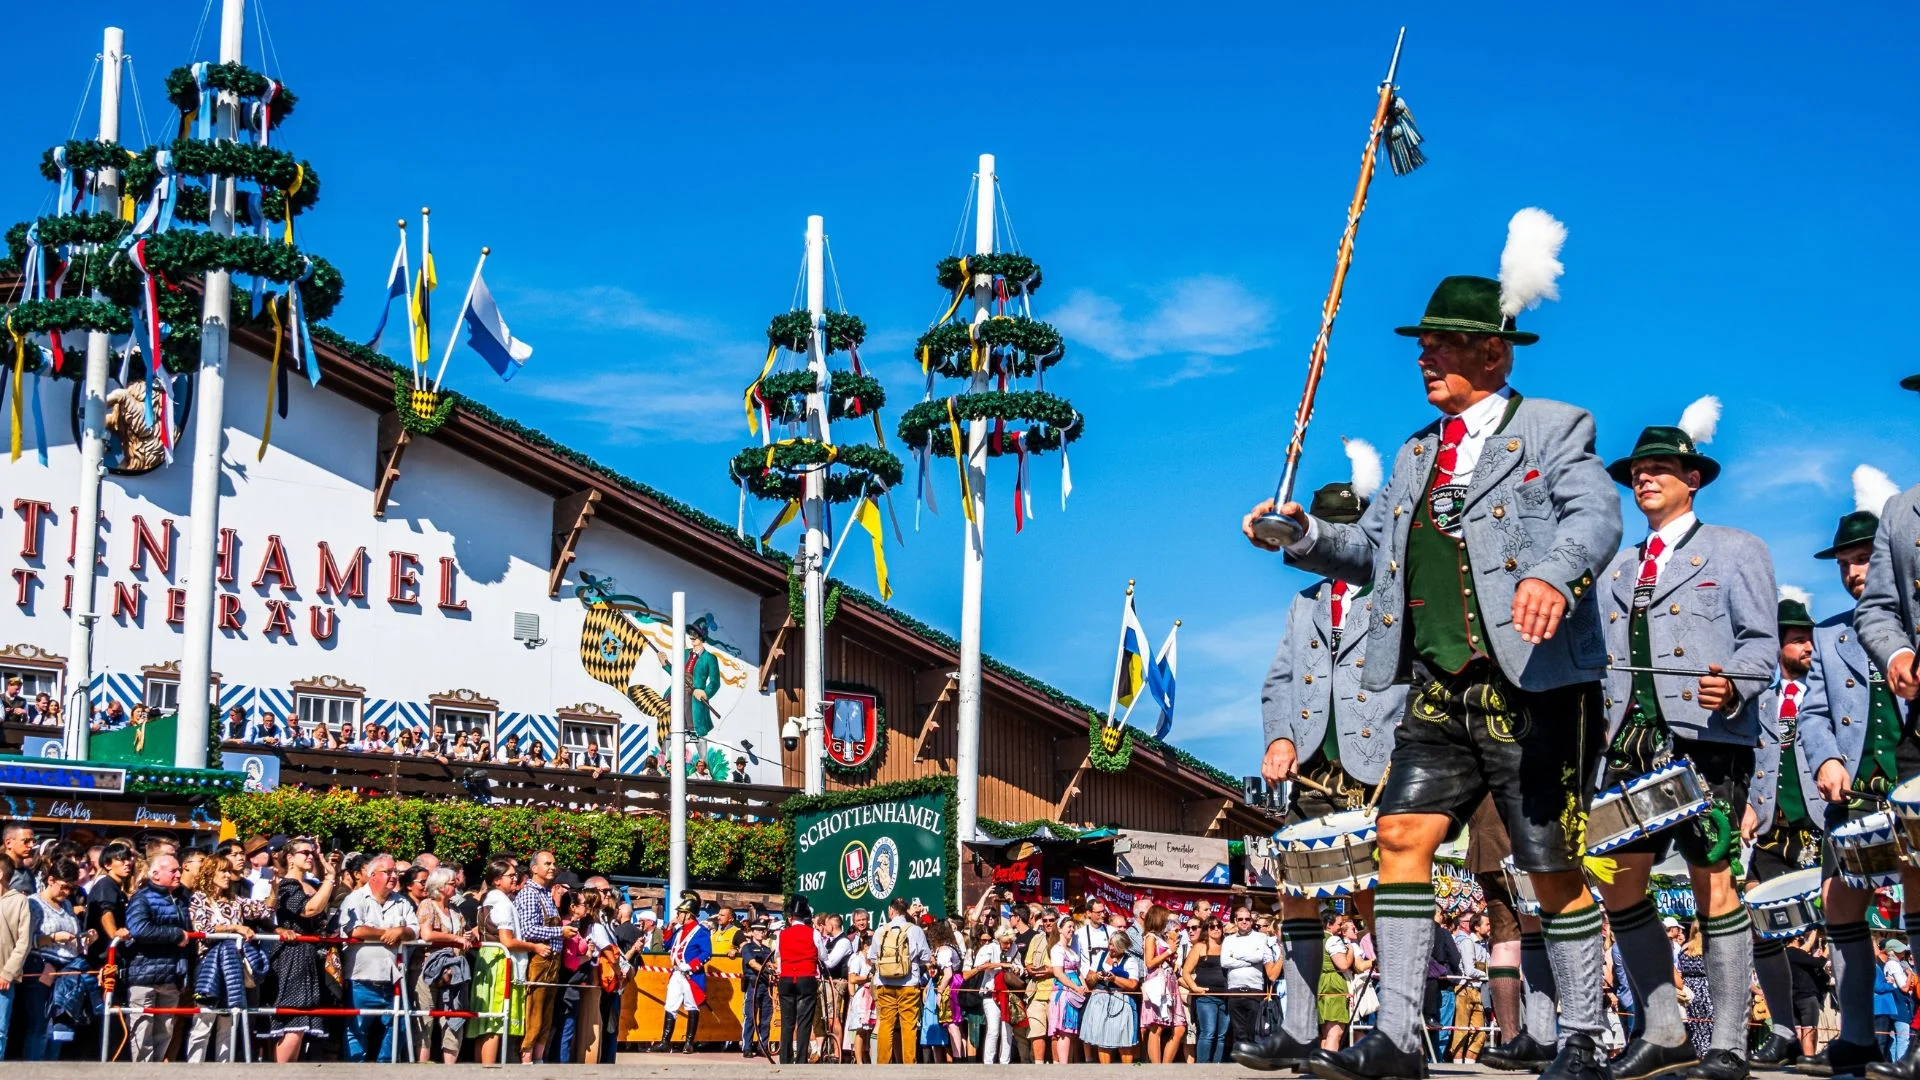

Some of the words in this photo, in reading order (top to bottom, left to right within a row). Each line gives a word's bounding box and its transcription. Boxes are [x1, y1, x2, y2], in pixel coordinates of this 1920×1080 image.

[134, 806, 177, 826] Pommes
[799, 803, 941, 853] SCHOTTENHAMEL
[908, 857, 941, 881] 2024
[798, 871, 827, 892] 1867
[847, 876, 868, 891] SPATEN
[1053, 881, 1062, 890] 37
